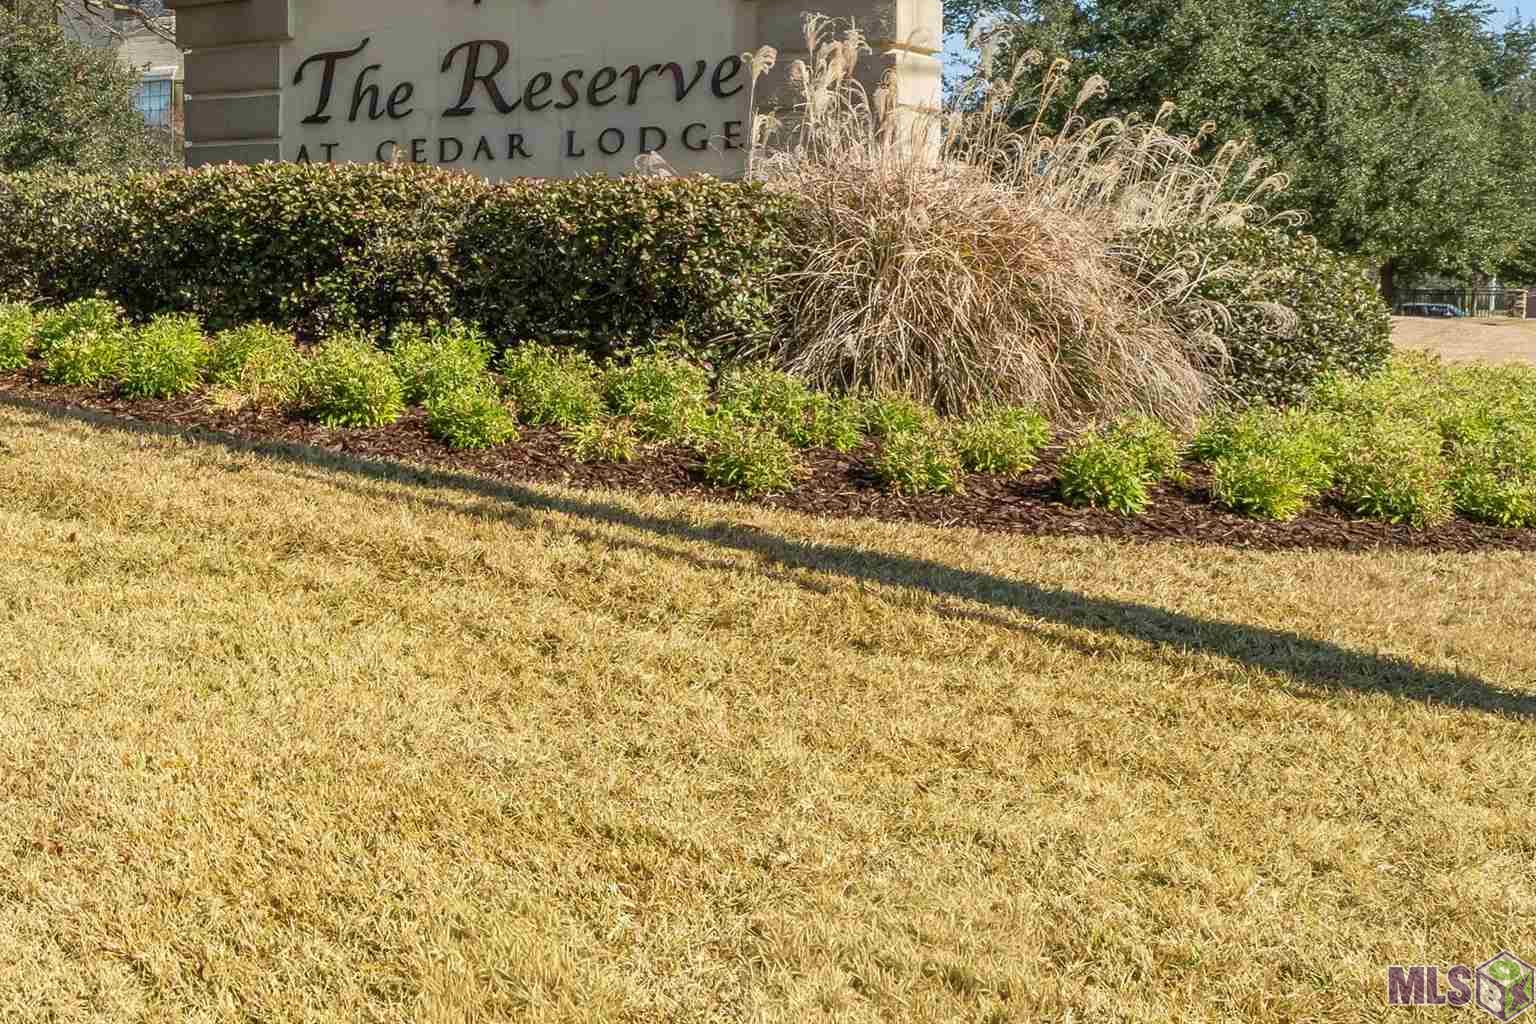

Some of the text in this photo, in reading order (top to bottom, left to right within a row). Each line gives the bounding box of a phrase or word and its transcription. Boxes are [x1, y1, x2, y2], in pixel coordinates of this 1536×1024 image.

[293, 37, 745, 125] The Reserve
[295, 120, 745, 164] AT CEDAR LODGE
